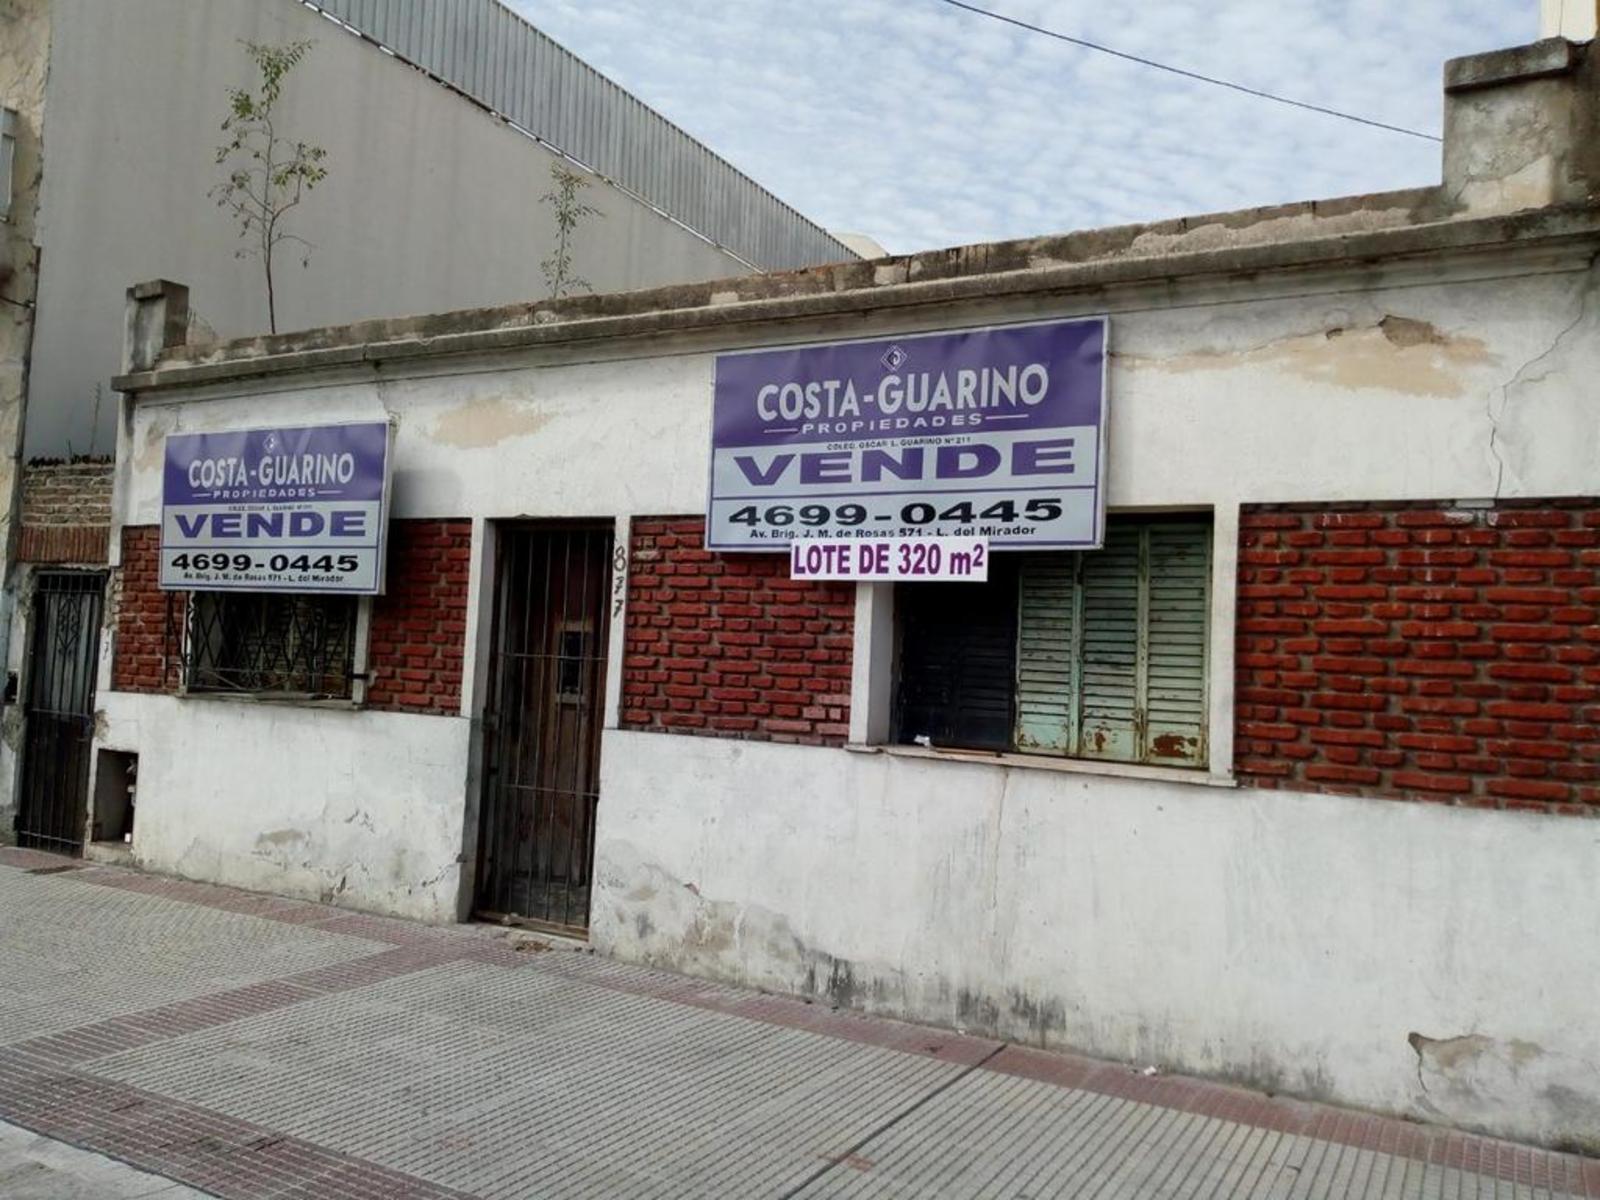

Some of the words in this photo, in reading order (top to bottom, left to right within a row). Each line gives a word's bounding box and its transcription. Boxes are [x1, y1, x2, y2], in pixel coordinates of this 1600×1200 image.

[757, 363, 1049, 421] COSTA-GUARINO
[802, 413, 982, 434] PROPIEDADES
[859, 441, 887, 449] OSCAR
[900, 438, 941, 446] GUARINO
[188, 452, 354, 489] COSTA-GUARINO
[734, 438, 1075, 487] VENDE
[213, 488, 316, 499] PROPIEDADES
[174, 511, 366, 538] VENDE
[728, 498, 1063, 527] 4699-0445
[750, 529, 767, 538] Av.
[771, 529, 798, 539] Brig.
[803, 529, 813, 538] J.
[818, 529, 832, 538] M.
[836, 528, 851, 538] de
[856, 528, 895, 538] Rosas
[899, 527, 922, 537] 571
[936, 527, 948, 537] L.
[954, 527, 974, 537] del
[980, 526, 1036, 537] Mirador
[171, 553, 359, 572] 4699-0445
[793, 544, 851, 574] LOTE
[859, 543, 890, 574] DE
[898, 543, 942, 574] 320
